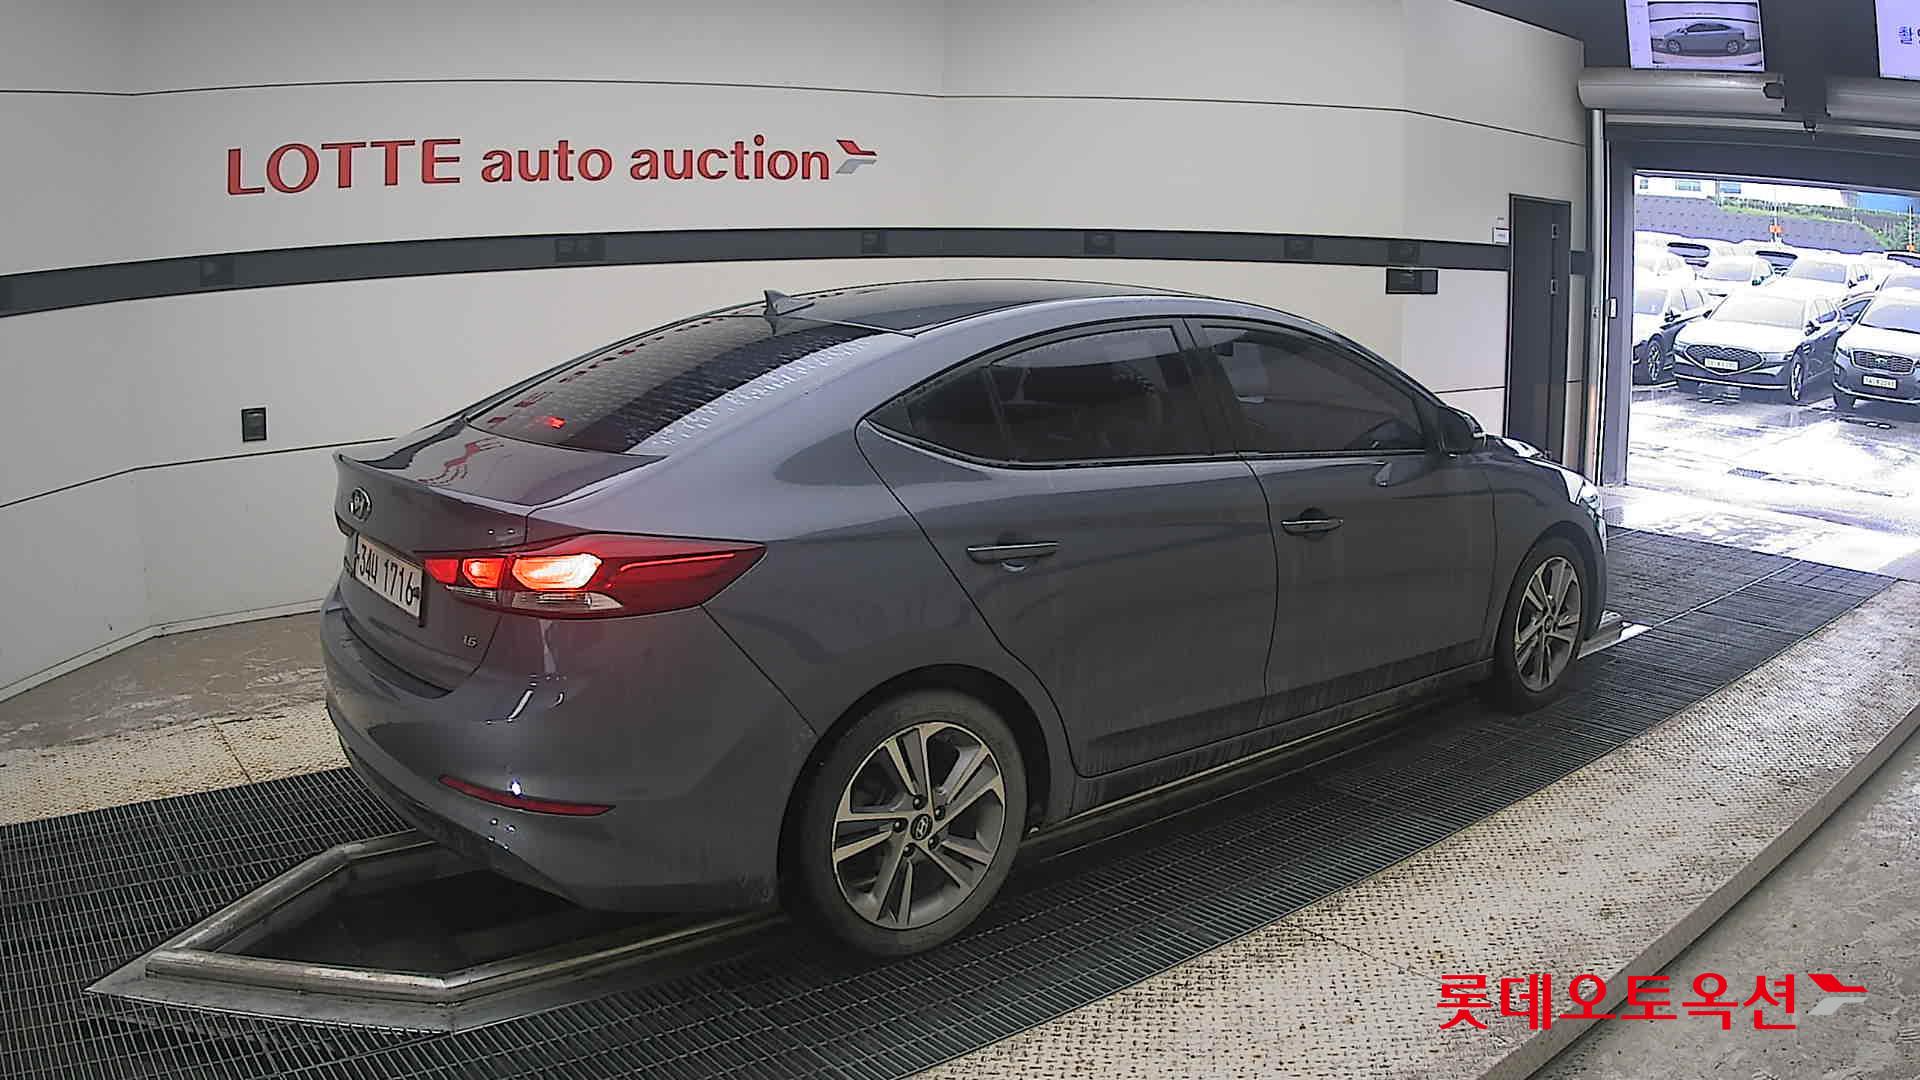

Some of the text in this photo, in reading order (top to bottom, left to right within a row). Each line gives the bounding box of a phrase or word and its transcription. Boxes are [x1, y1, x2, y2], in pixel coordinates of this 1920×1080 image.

[227, 135, 830, 195] LOTTE auto auction
[384, 559, 414, 606] 1716
